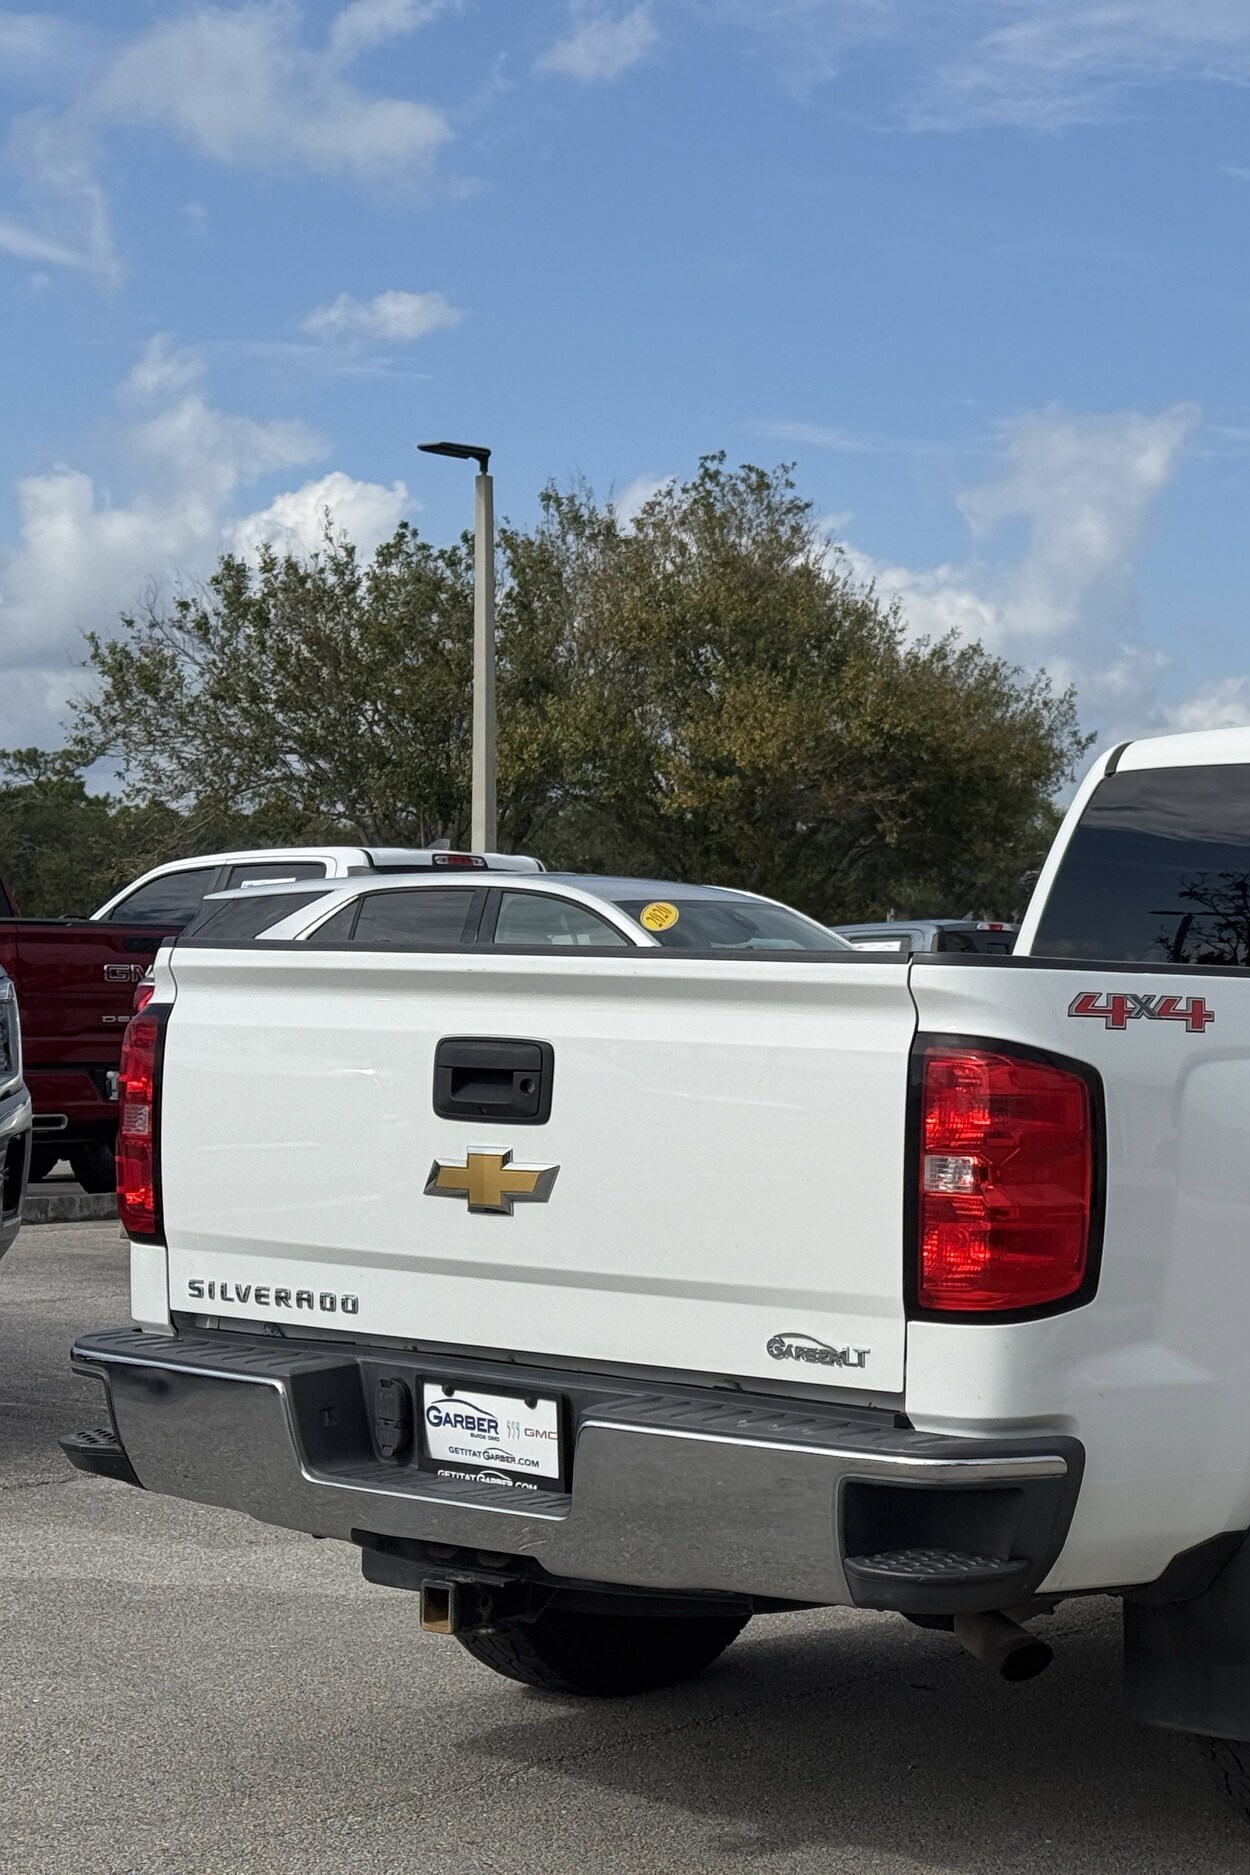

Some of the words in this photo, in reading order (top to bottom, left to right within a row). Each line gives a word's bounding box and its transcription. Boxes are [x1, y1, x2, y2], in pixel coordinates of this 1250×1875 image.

[646, 904, 672, 928] 2020
[103, 964, 154, 983] GM
[188, 1279, 359, 1315] SILVERADO
[841, 1347, 871, 1368] LT
[426, 1405, 499, 1435] GARBER
[524, 1428, 558, 1441] GMC
